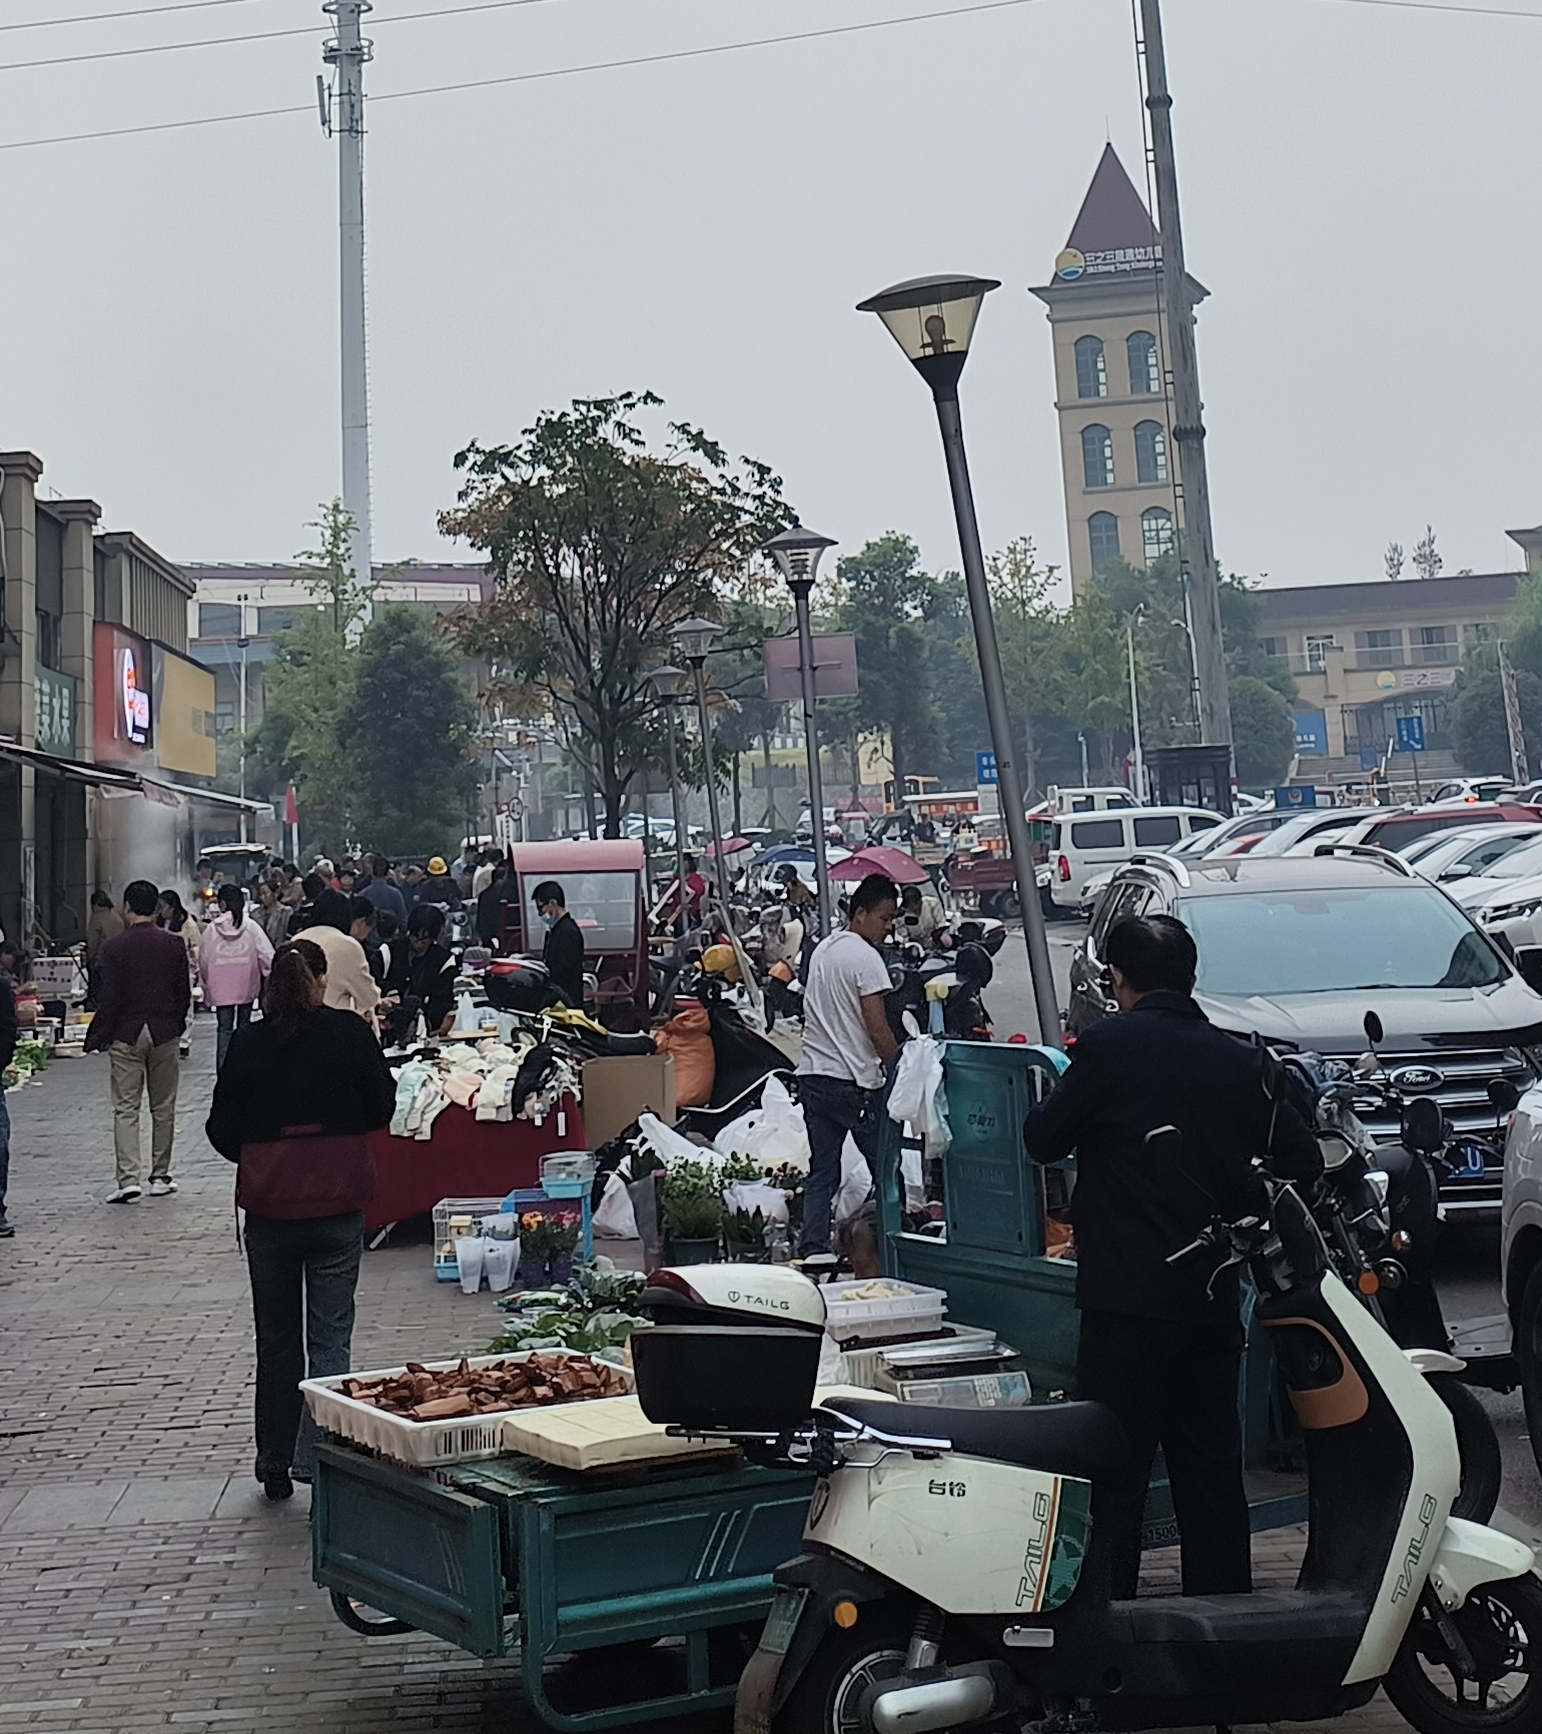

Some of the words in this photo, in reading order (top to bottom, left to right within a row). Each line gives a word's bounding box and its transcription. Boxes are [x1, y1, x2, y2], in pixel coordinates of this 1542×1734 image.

[1403, 1070, 1432, 1084] Ford
[744, 1294, 790, 1310] TAILG
[928, 1479, 966, 1497] 台铃
[1015, 1491, 1051, 1607] TAILG
[1391, 1494, 1438, 1604] TAILG
